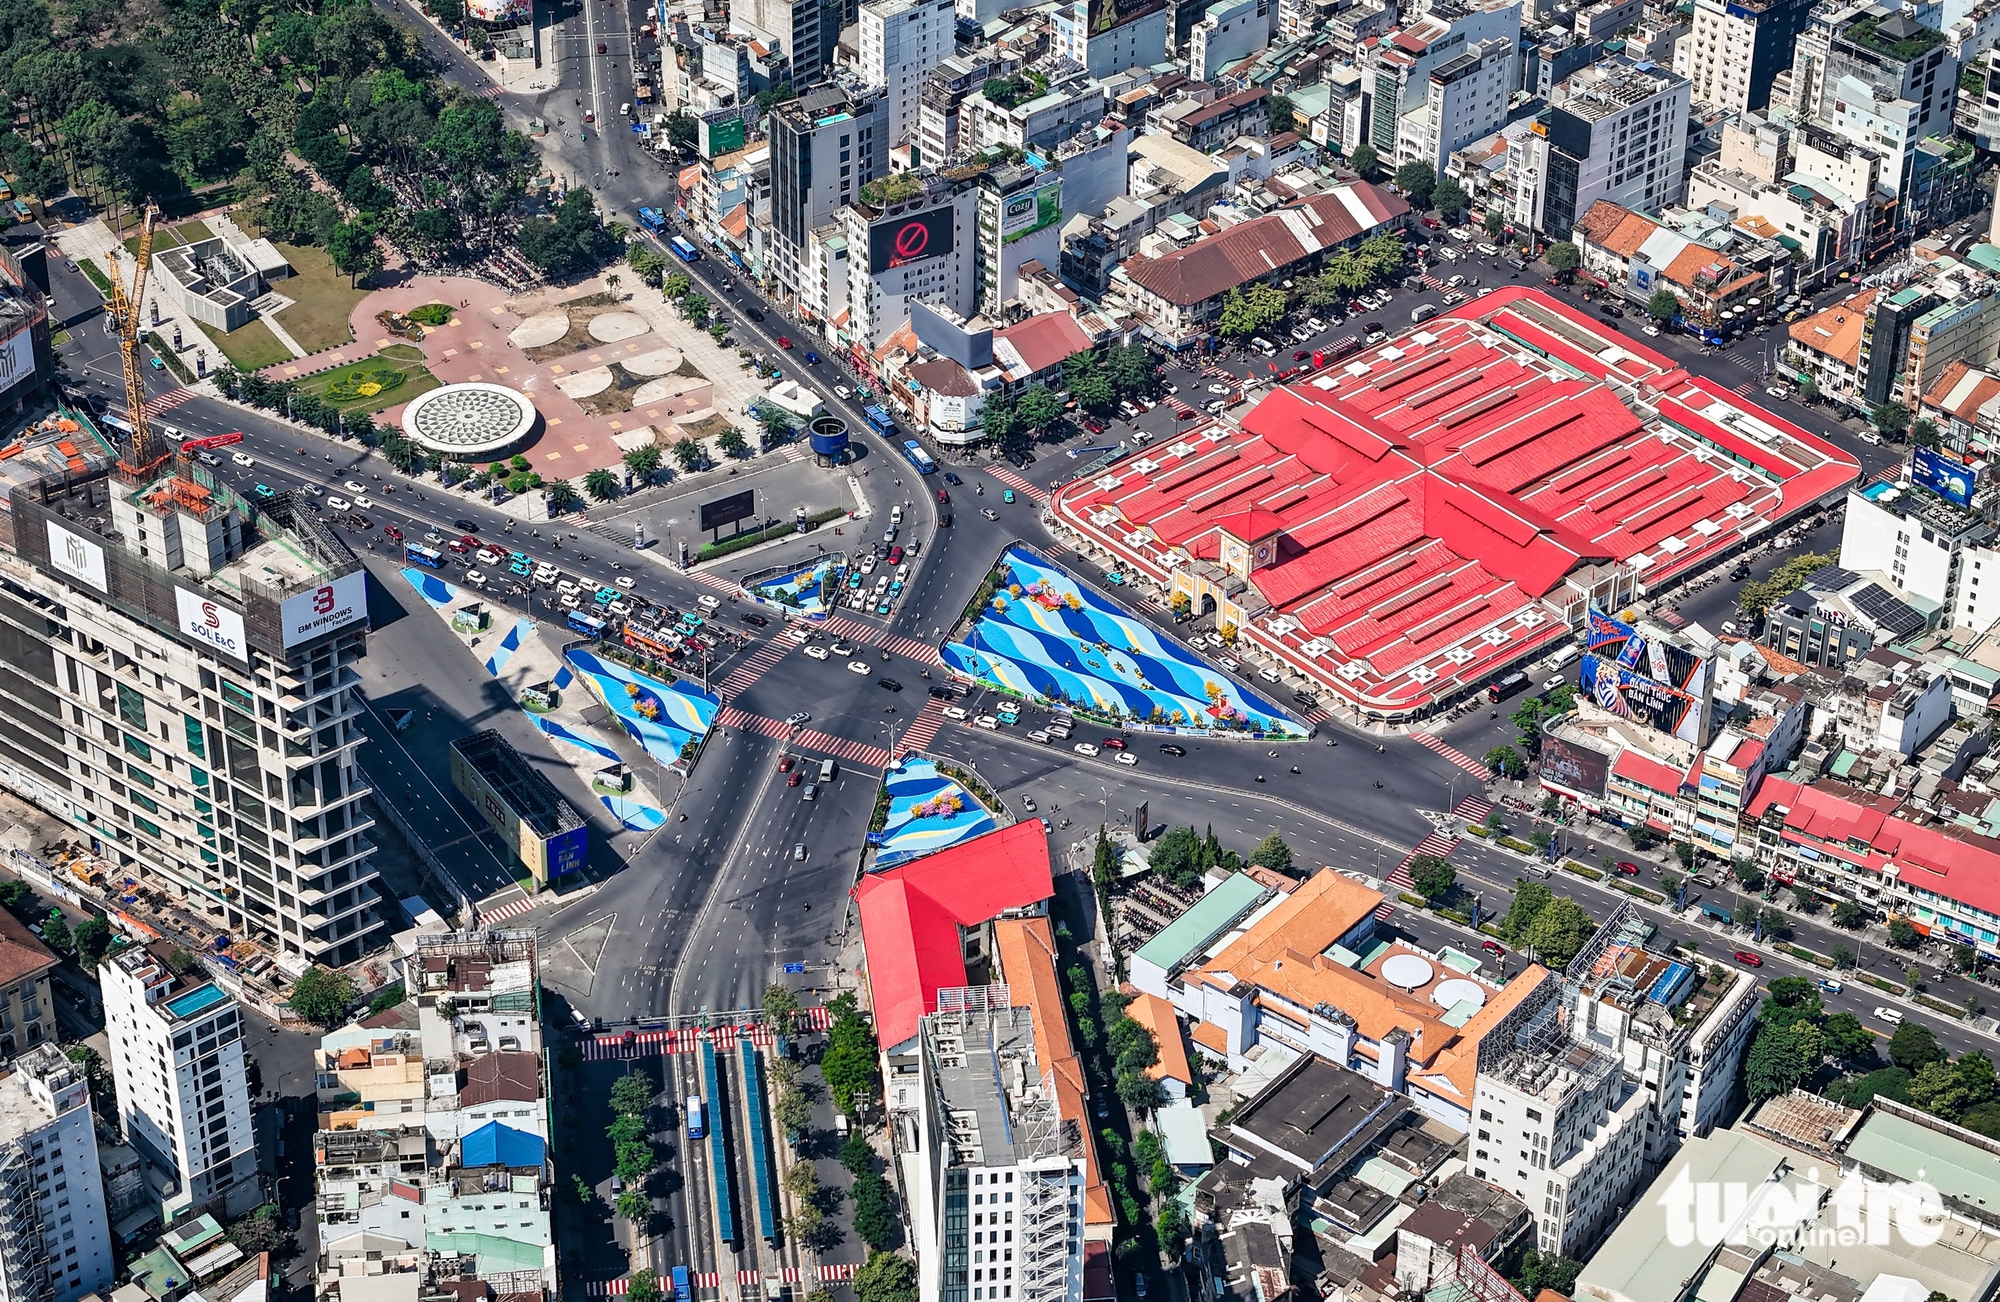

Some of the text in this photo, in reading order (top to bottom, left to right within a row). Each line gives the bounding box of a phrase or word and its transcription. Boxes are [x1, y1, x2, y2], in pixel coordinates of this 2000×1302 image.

[1820, 141, 1838, 153] HALO
[1009, 198, 1031, 214] Cozy
[54, 560, 104, 591] MASTERISE HOMES
[298, 607, 353, 634] BM WINDOWS
[191, 621, 213, 641] SOL
[214, 632, 236, 651] E&C
